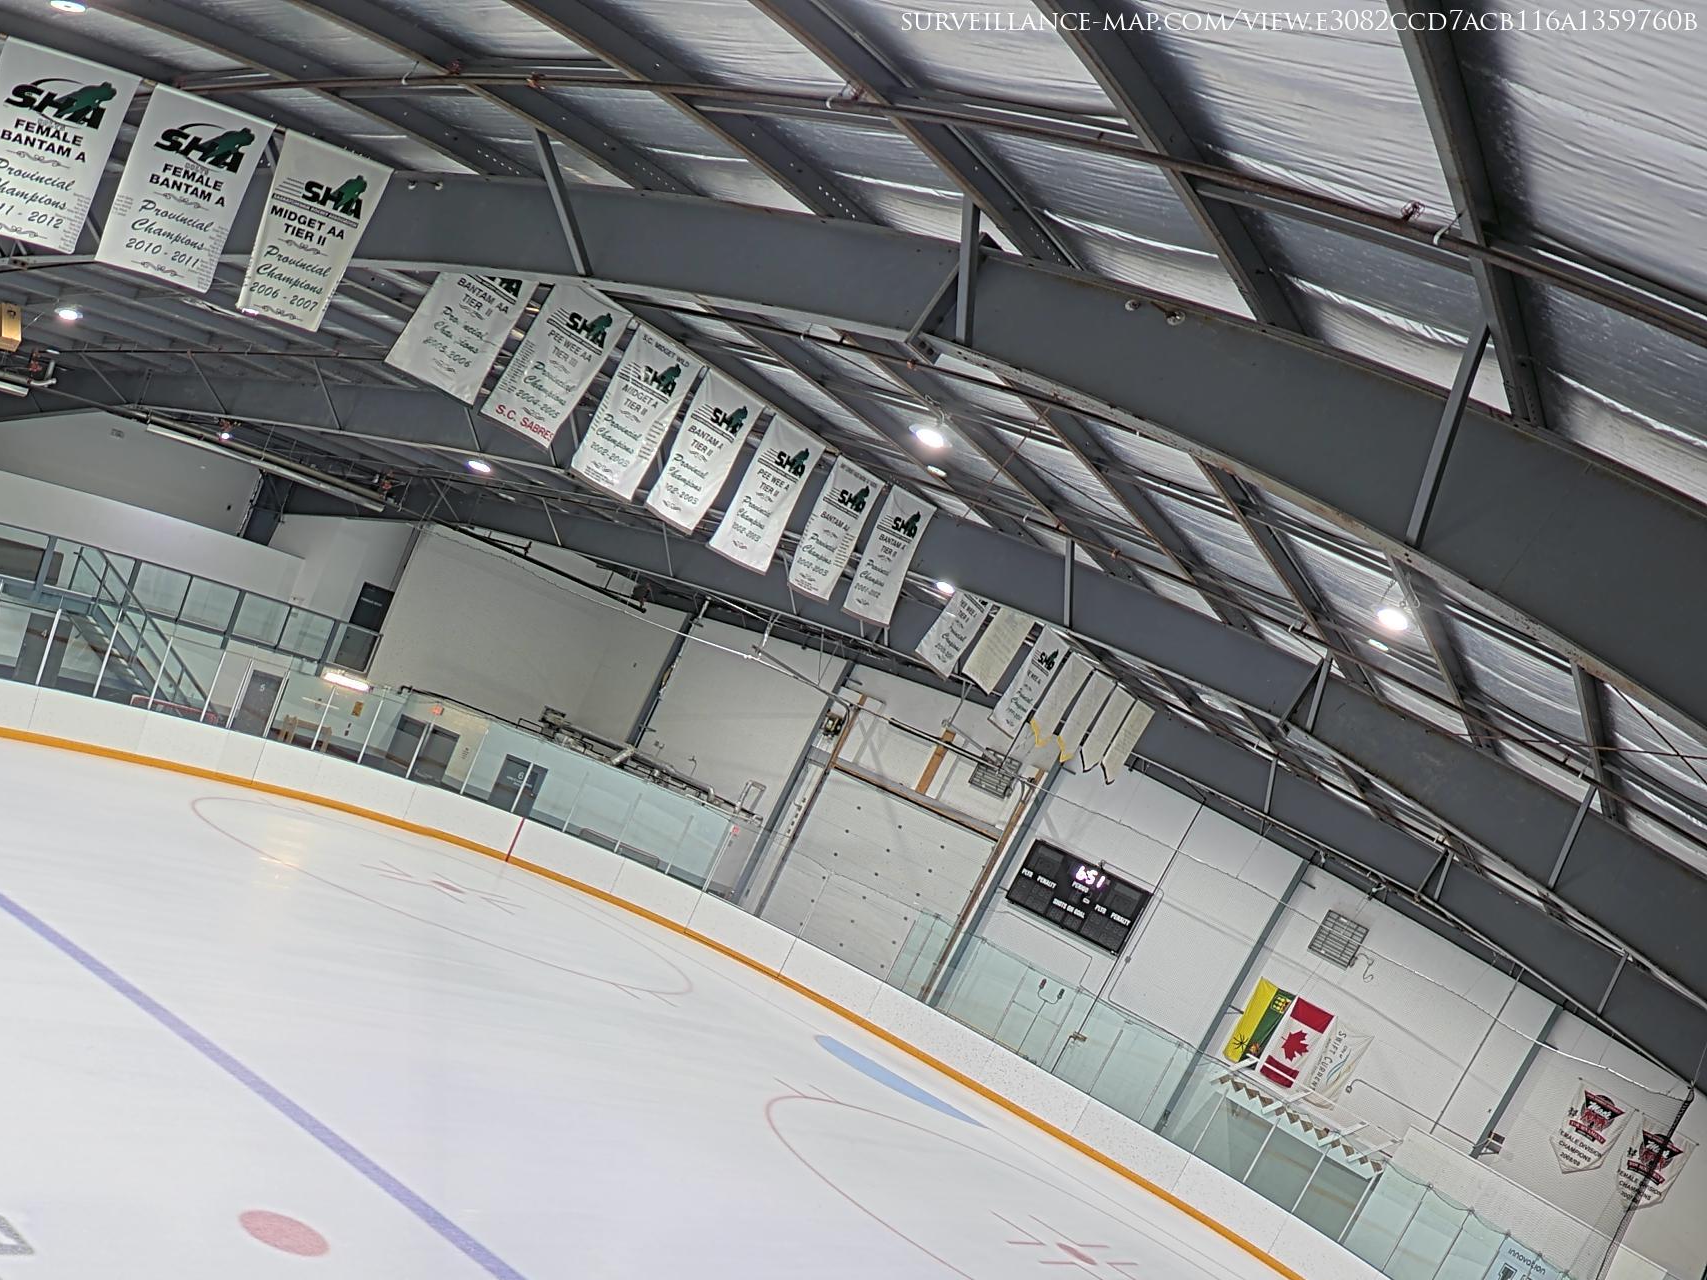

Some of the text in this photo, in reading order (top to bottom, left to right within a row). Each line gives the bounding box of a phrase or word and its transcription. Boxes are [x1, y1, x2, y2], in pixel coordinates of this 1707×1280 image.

[4, 83, 106, 130] SHA
[0, 129, 86, 163] BANTAM A
[14, 118, 84, 147] FEMALE
[154, 128, 245, 174] SHA
[149, 174, 225, 208] BANTAM A
[162, 163, 224, 192] FEMALE
[302, 181, 363, 219] SHA
[28, 211, 65, 229] 2012
[139, 199, 213, 233] Provincial
[270, 205, 325, 231] MIDGET
[327, 226, 345, 240] AA
[131, 218, 205, 251] Champions
[284, 223, 327, 246] TIER II
[126, 237, 200, 268] 2010 2011
[264, 245, 332, 278] Provincial
[256, 263, 324, 295] Champions
[457, 278, 495, 305] BANTAM
[249, 282, 319, 311] 2006 2007
[461, 293, 483, 310] TIER
[566, 312, 607, 349] SHA
[547, 330, 593, 362] PEE WEE AA
[551, 346, 568, 362] TIER
[495, 404, 517, 422] S.C.
[623, 398, 641, 412] TIER
[690, 440, 708, 454] TIER
[757, 468, 785, 488] PEE WEE
[759, 482, 775, 494] TIER
[1311, 1030, 1347, 1091] SWIFT CURRENT
[1559, 1140, 1591, 1163] CHAMPIONS
[1508, 1248, 1545, 1275] innovation
